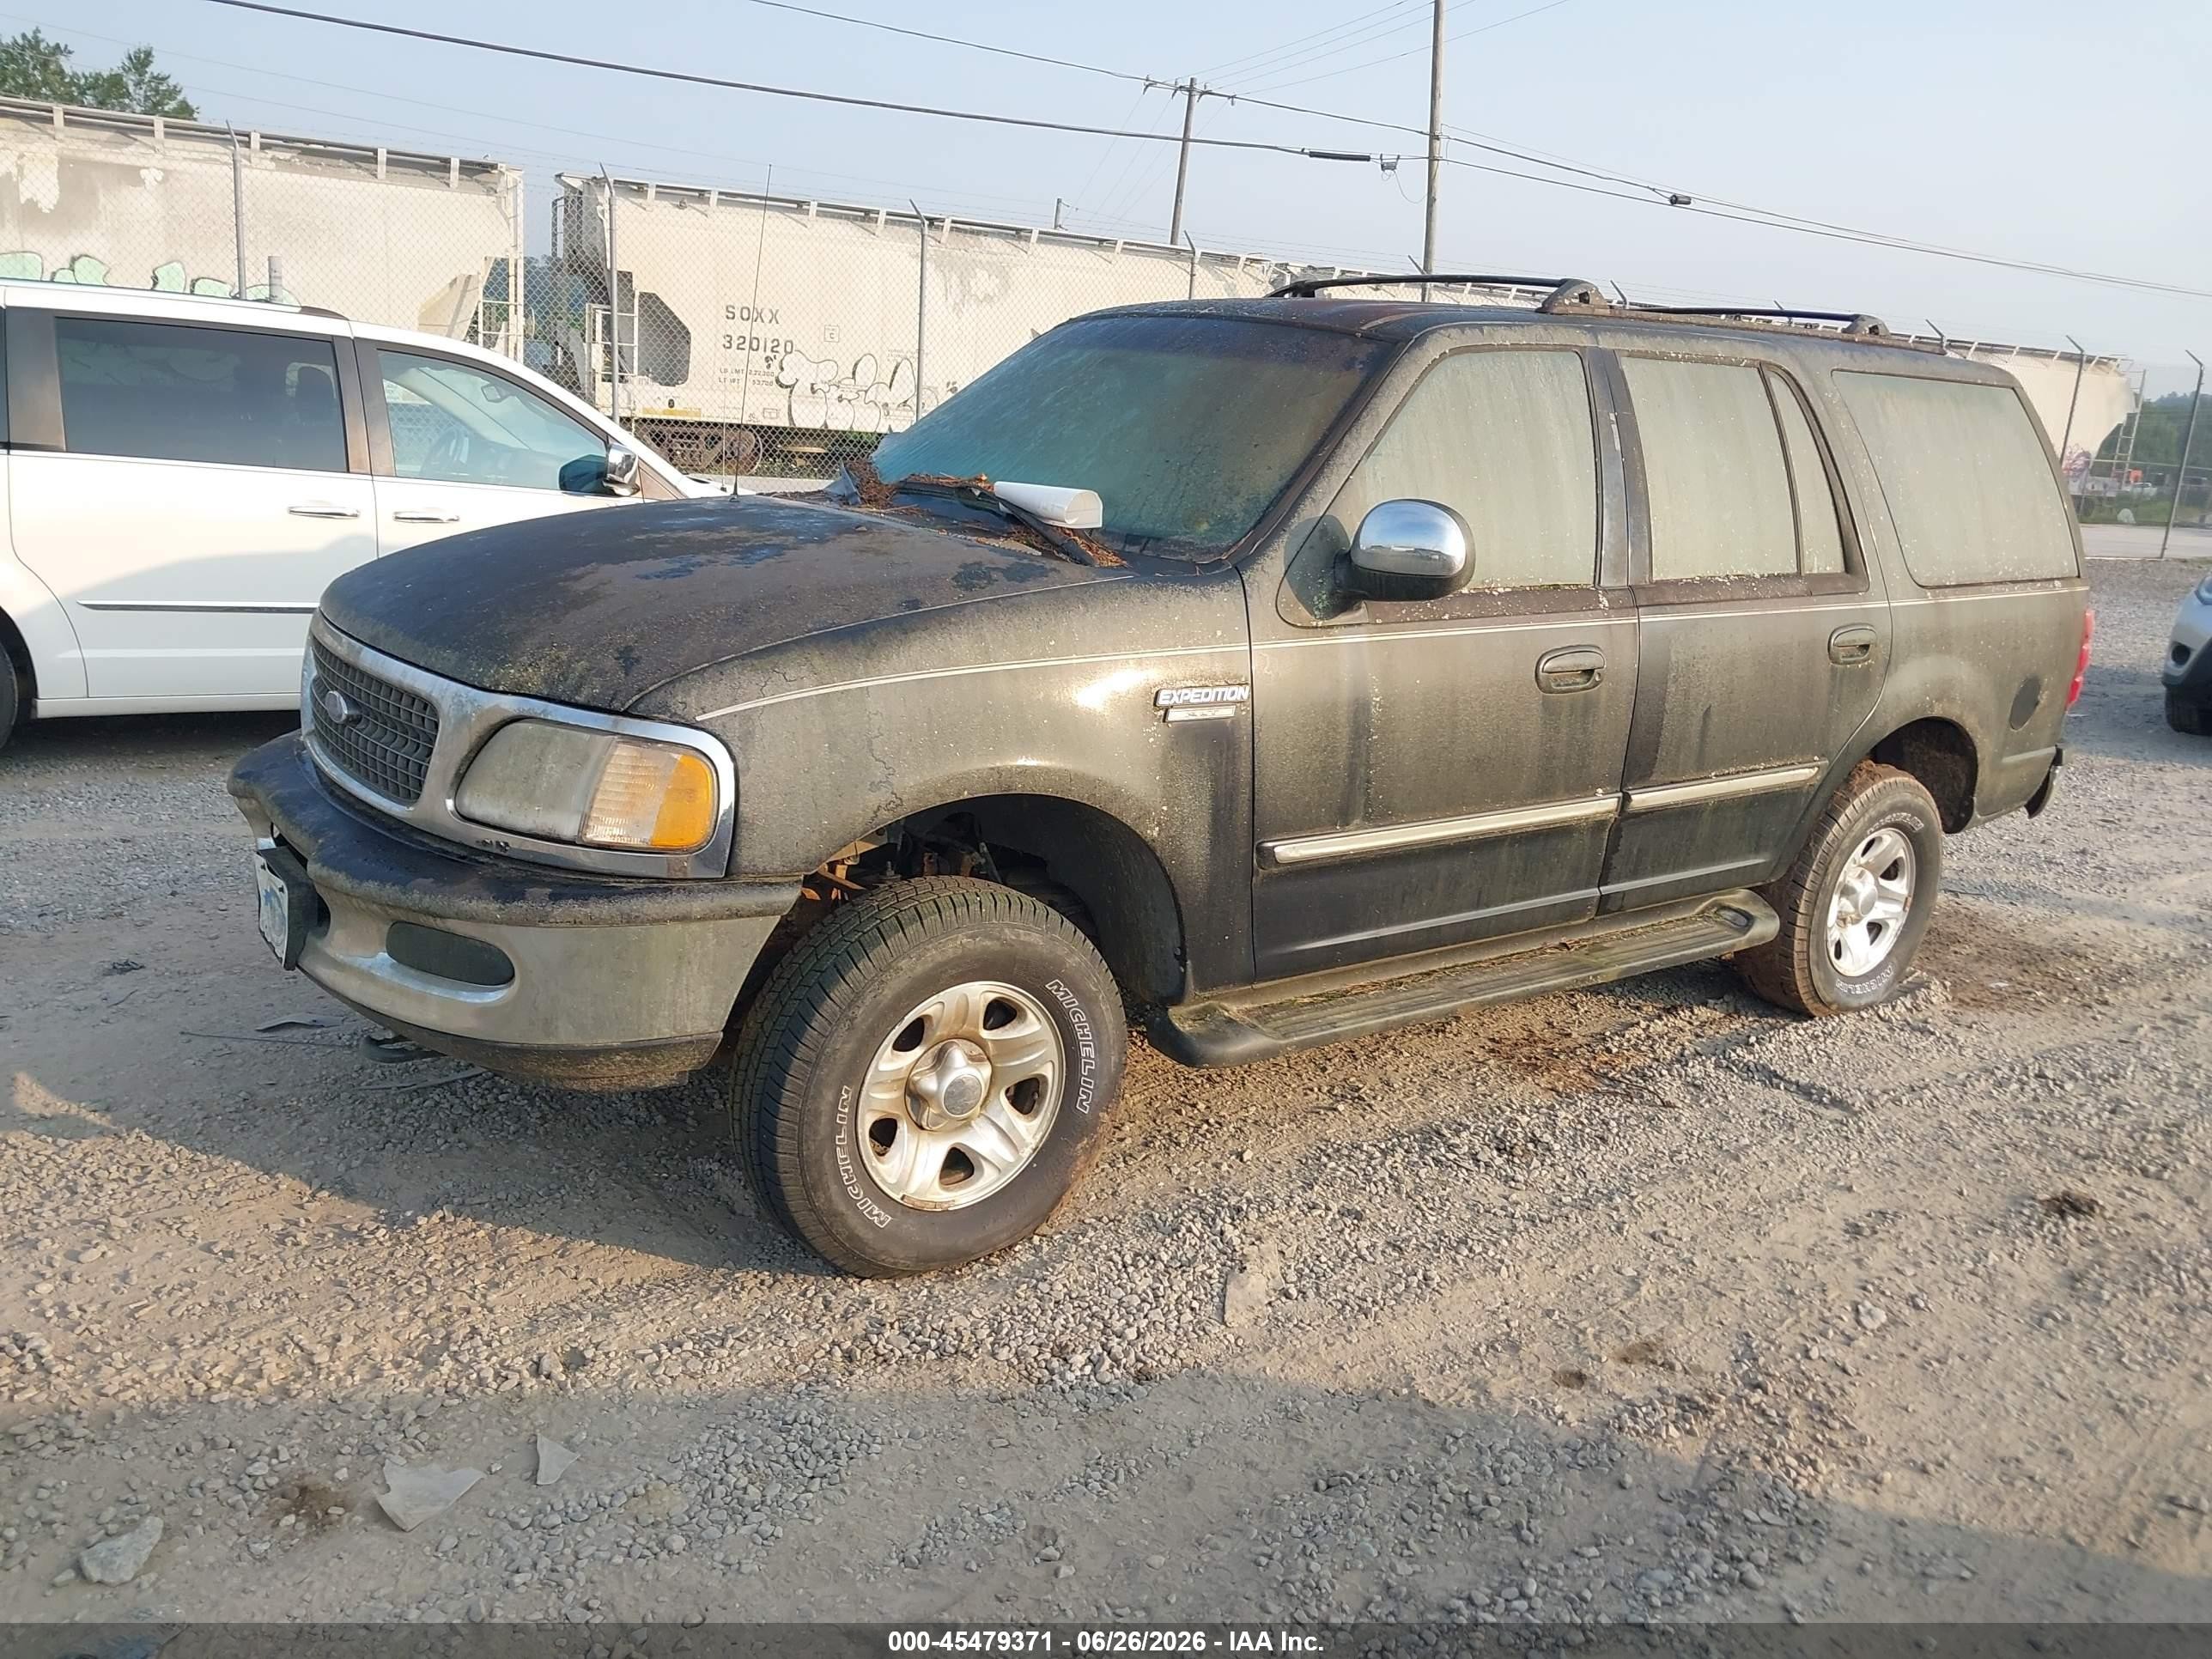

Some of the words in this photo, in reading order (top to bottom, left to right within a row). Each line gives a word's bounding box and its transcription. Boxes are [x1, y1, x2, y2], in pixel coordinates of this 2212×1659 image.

[726, 305, 780, 325] SOXX
[722, 334, 793, 355] 320120
[1158, 686, 1250, 704] EXPEDITION
[1045, 979, 1096, 1114] MICHELIN
[836, 1085, 894, 1229] MICHELIN
